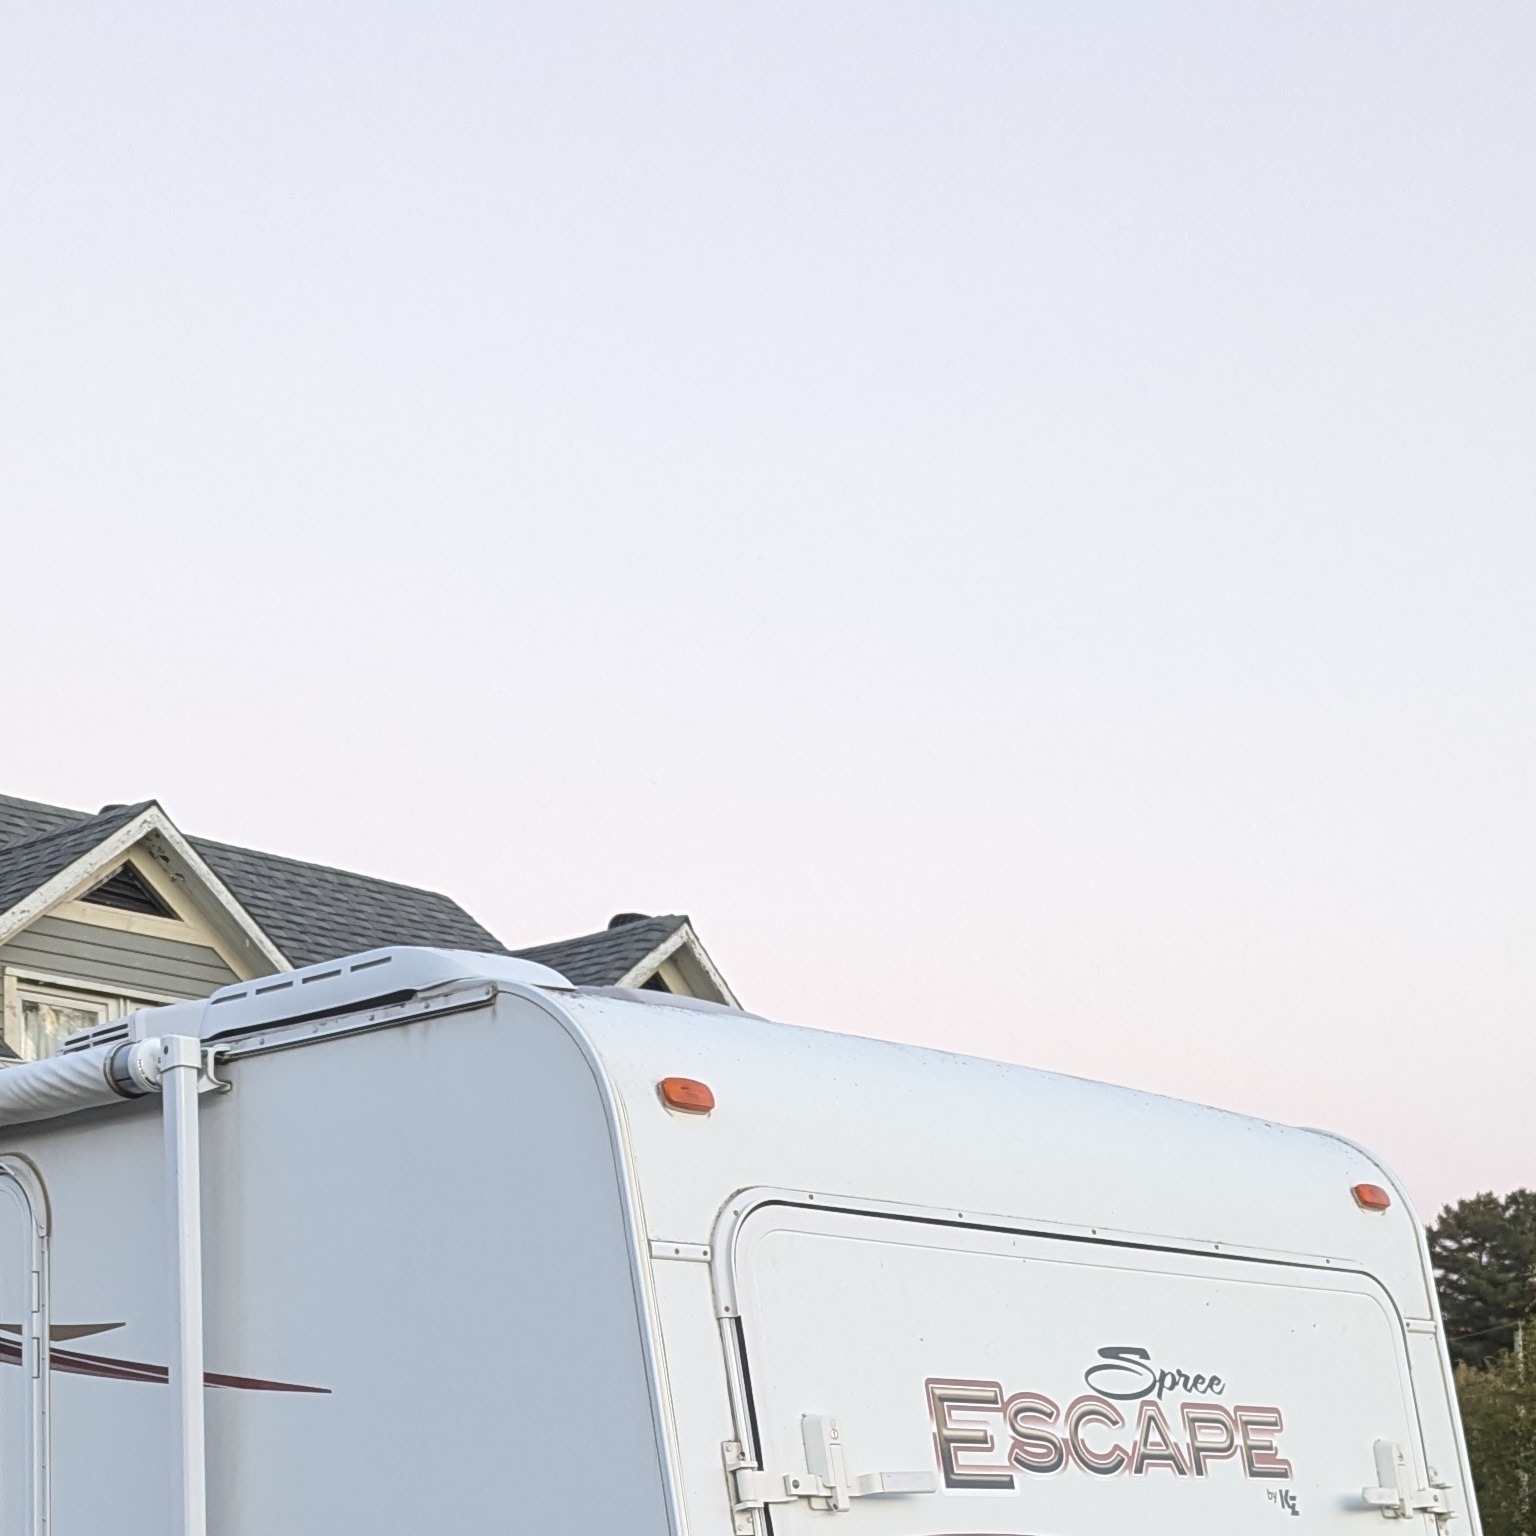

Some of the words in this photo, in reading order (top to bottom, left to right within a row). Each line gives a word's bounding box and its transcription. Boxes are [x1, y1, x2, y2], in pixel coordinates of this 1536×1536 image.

[1084, 1346, 1225, 1400] Spree
[925, 1378, 1293, 1492] ESCAPE
[1266, 1488, 1277, 1503] by
